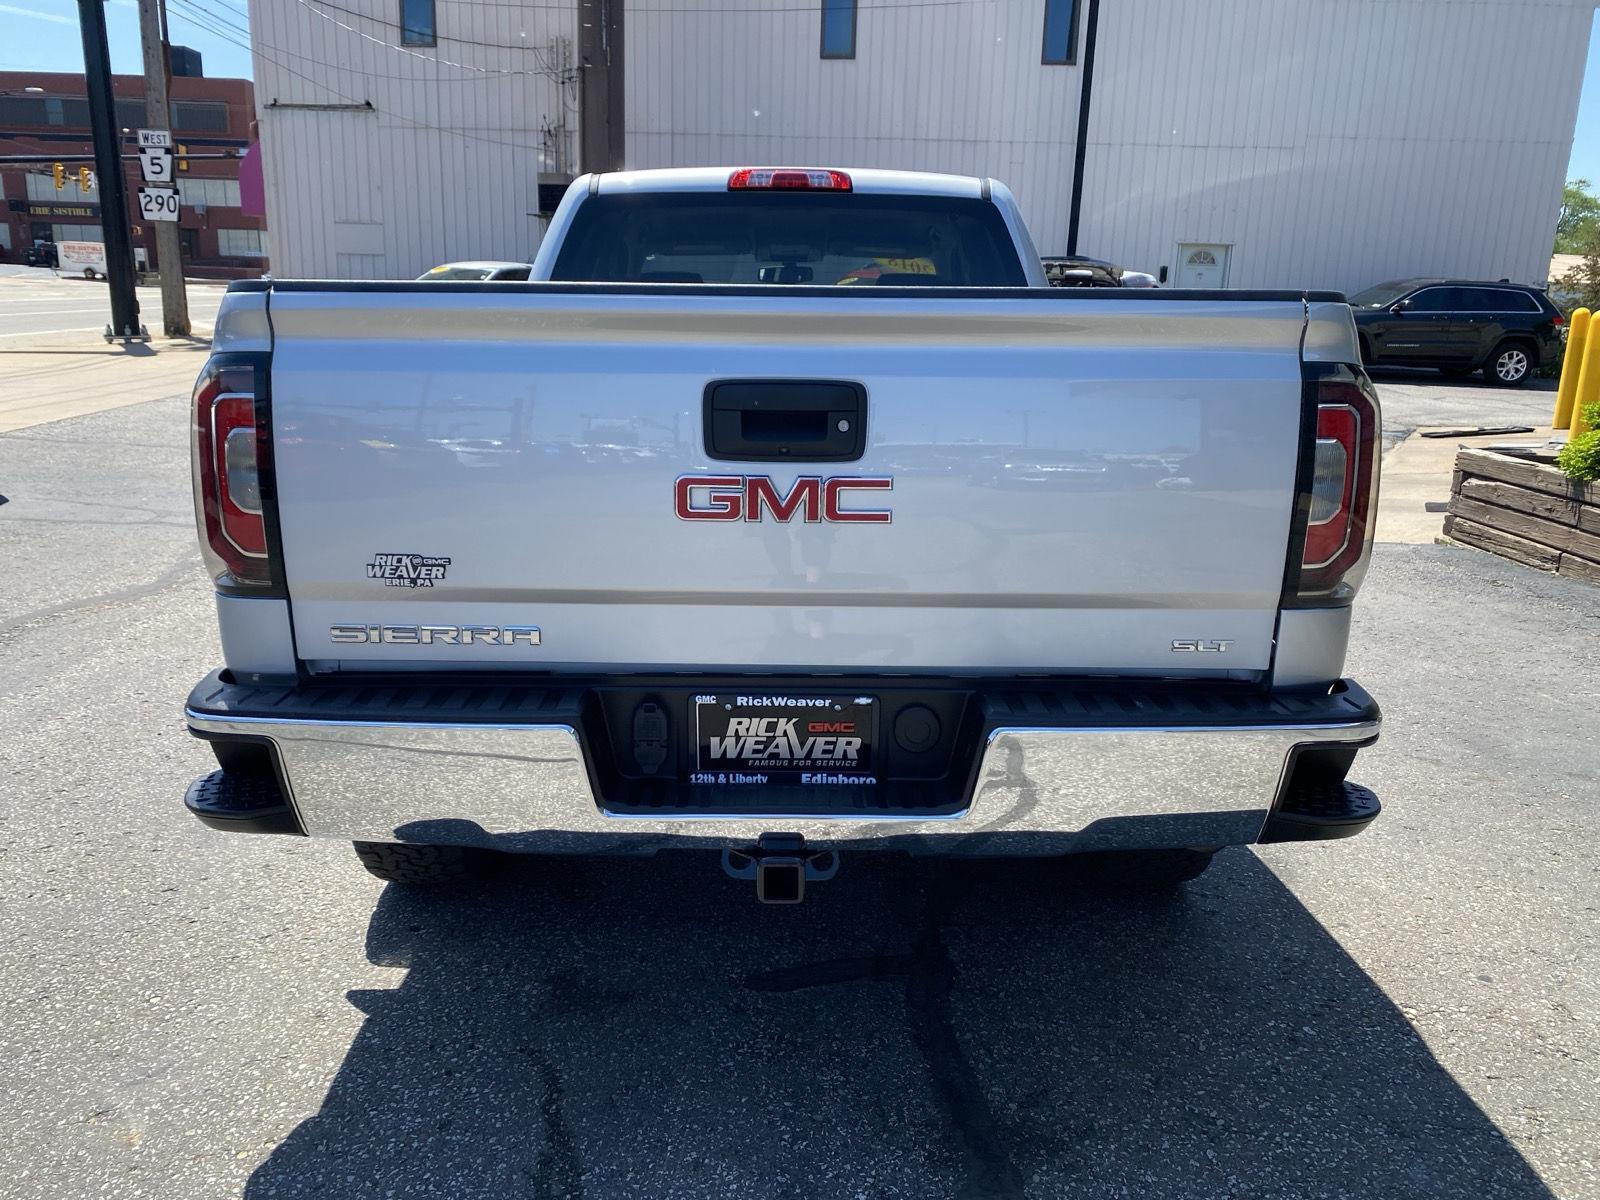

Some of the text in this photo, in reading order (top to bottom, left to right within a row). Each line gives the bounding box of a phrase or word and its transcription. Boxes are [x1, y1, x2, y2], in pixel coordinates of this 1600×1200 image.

[141, 132, 167, 145] WEST
[150, 156, 164, 175] 5
[143, 194, 177, 213] 290
[674, 474, 894, 524] GMC
[374, 555, 412, 566] RICK
[367, 565, 445, 579] WEAVER
[416, 579, 432, 587] PA
[330, 623, 542, 646] SIERRA
[1171, 639, 1234, 652] SLT
[695, 695, 832, 707] GMC RickWeaver
[726, 717, 855, 737] RICK GMC
[710, 736, 862, 760] WEAVER
[748, 759, 858, 767] FAMOUS FOR SERVICE
[690, 773, 715, 784] 12th
[717, 773, 727, 784] &
